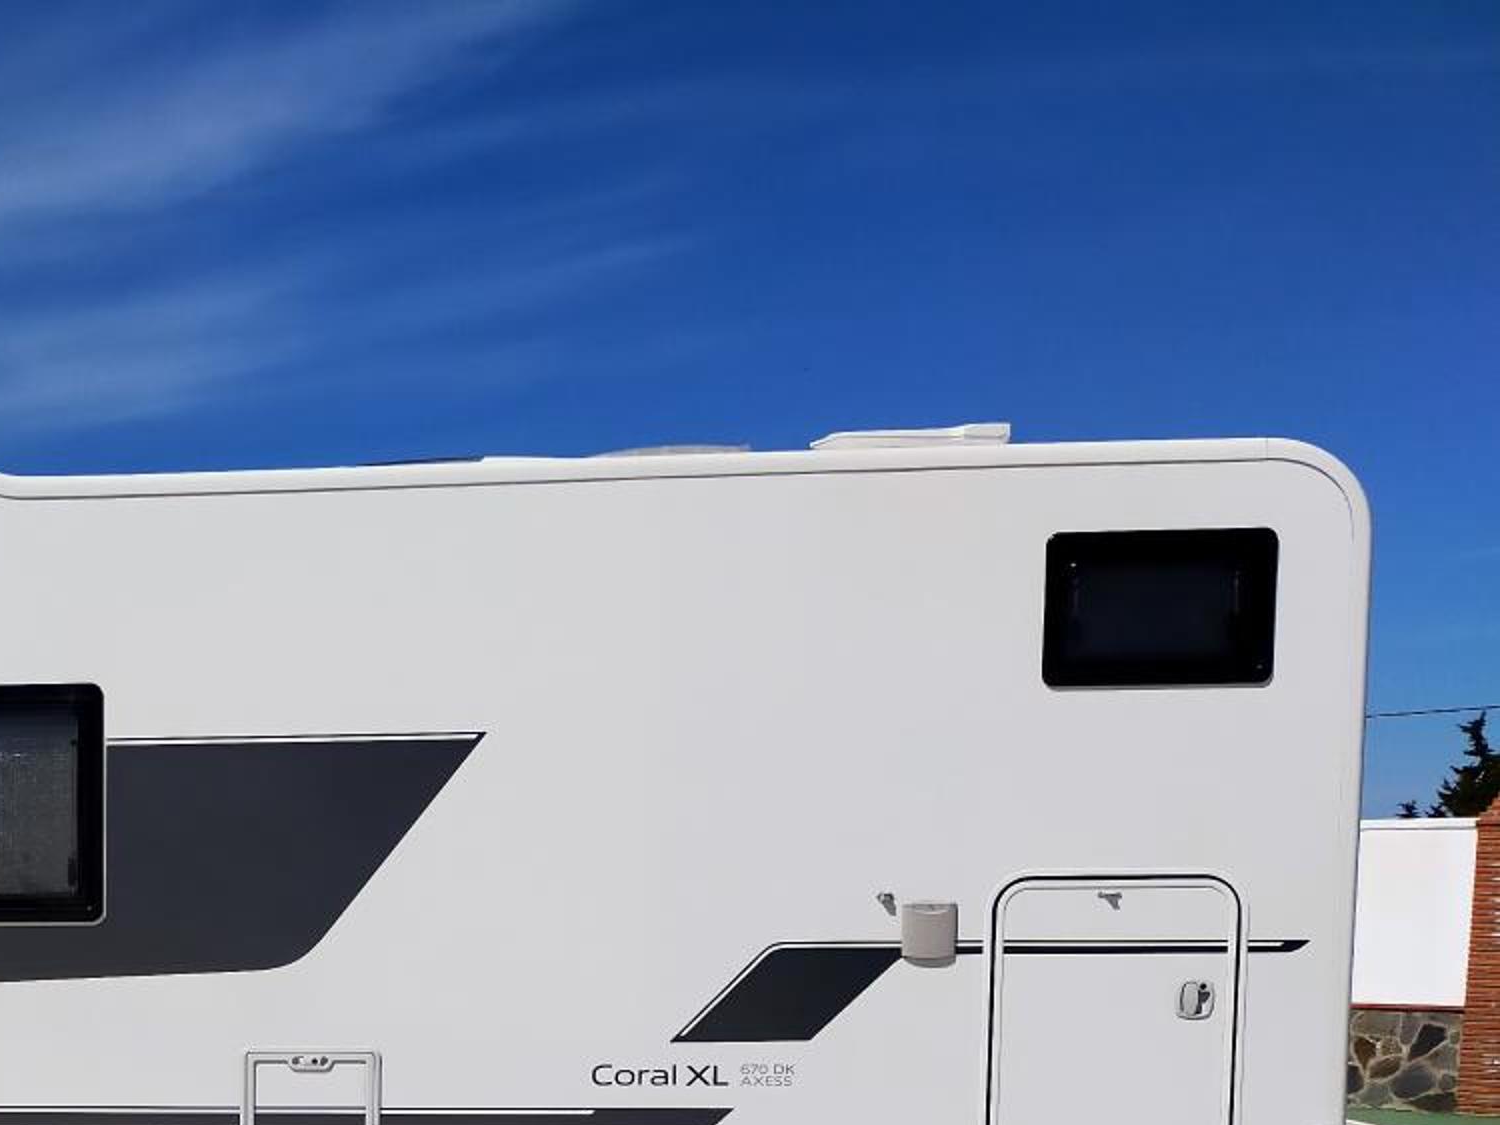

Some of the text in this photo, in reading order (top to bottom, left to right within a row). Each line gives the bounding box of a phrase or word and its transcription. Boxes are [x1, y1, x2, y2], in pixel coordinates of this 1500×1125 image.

[740, 1063, 796, 1075] 670 DK
[591, 1064, 729, 1087] Coral XL
[740, 1075, 793, 1087] AXESS
